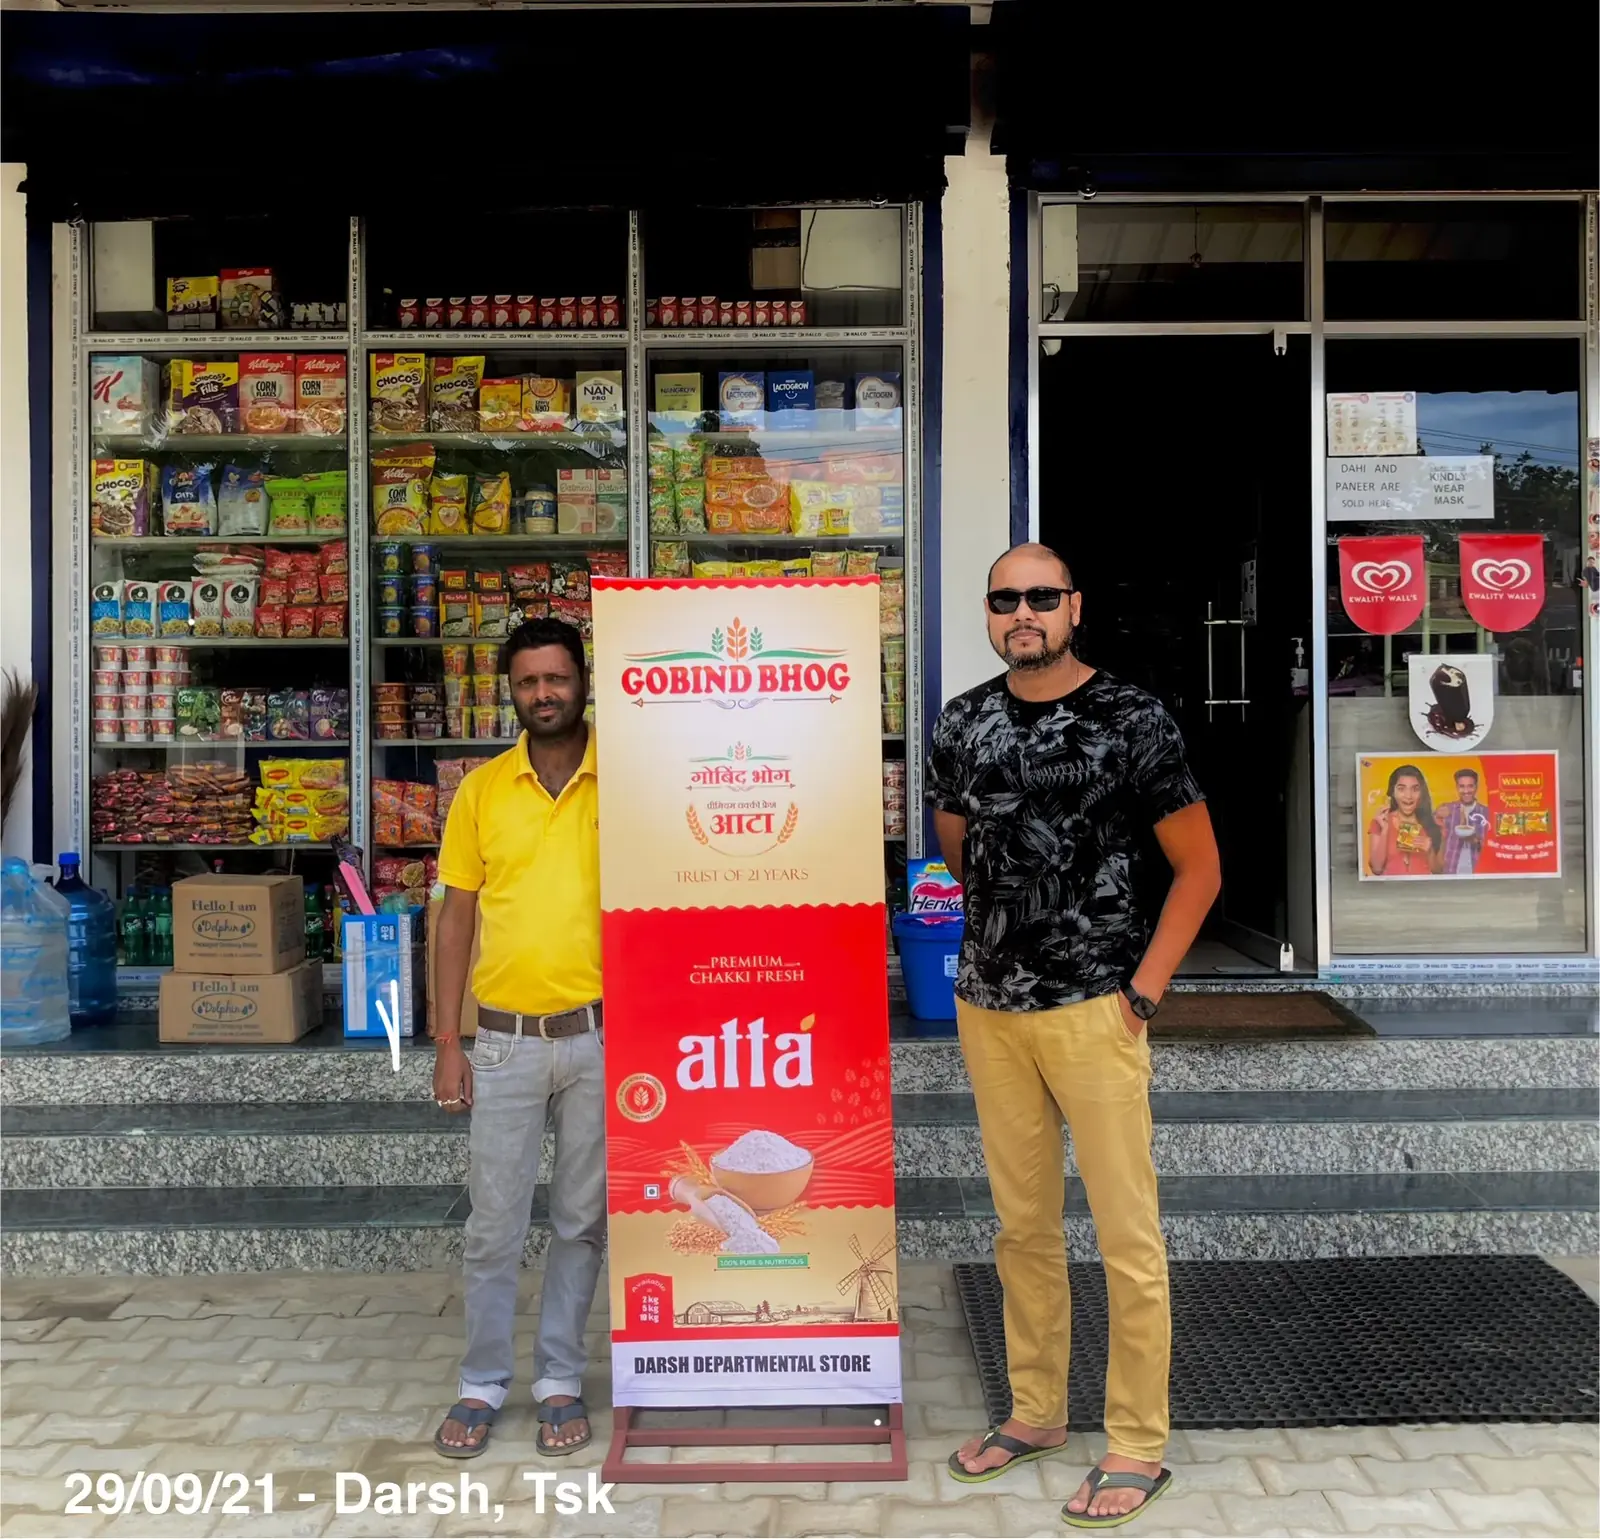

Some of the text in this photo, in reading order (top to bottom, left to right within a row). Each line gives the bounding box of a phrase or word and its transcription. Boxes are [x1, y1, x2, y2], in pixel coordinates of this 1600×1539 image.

[248, 359, 285, 373] Kellogg's
[304, 360, 341, 373] Kellogg's
[255, 380, 277, 392] CORN
[302, 380, 321, 392] CORN
[376, 373, 420, 388] CHOCOS
[433, 378, 474, 393] CHOCOS
[200, 383, 220, 393] Fills
[584, 385, 614, 396] NAN
[660, 386, 696, 394] NANGROW
[773, 382, 809, 393] LACTOGROW
[726, 391, 758, 400] LACTOGEN
[862, 391, 893, 400] LACTOGEN
[1341, 463, 1398, 474] DAHI AND
[1429, 472, 1467, 482] KINDLY
[95, 478, 139, 492] CHOCOS
[1335, 481, 1400, 492] PANEER ARE
[1434, 484, 1465, 493] WEAR
[388, 488, 408, 497] CORN
[1342, 499, 1391, 509] SOLD HERE
[1434, 495, 1465, 505] MASK
[1349, 593, 1418, 603] KWALITY WALL'S
[1468, 592, 1537, 600] KWALITY WALL'S
[621, 662, 851, 696] GOBIND BHOG
[689, 764, 792, 785] गोबिंद भोग
[709, 813, 775, 835] आटा
[674, 868, 809, 883] TRUST OF 21 YEARS
[192, 900, 257, 911] Hello I am
[911, 895, 964, 913] Henko
[204, 919, 239, 938] Dolphin
[402, 916, 410, 954] Fortified
[710, 955, 783, 968] PREMIUM
[689, 969, 805, 984] CHAKKI FRESH
[192, 981, 259, 992] Hello I am
[403, 975, 411, 1008] Vitamin
[205, 1000, 240, 1019] Dolphin
[404, 1009, 411, 1017] A
[676, 1017, 814, 1091] atta
[764, 1258, 804, 1266] NUTRITIOUS
[648, 1295, 659, 1305] kg
[648, 1304, 659, 1314] kg
[648, 1313, 659, 1323] kg
[634, 1354, 871, 1374] DARSH DEPARTMENTAL STORE
